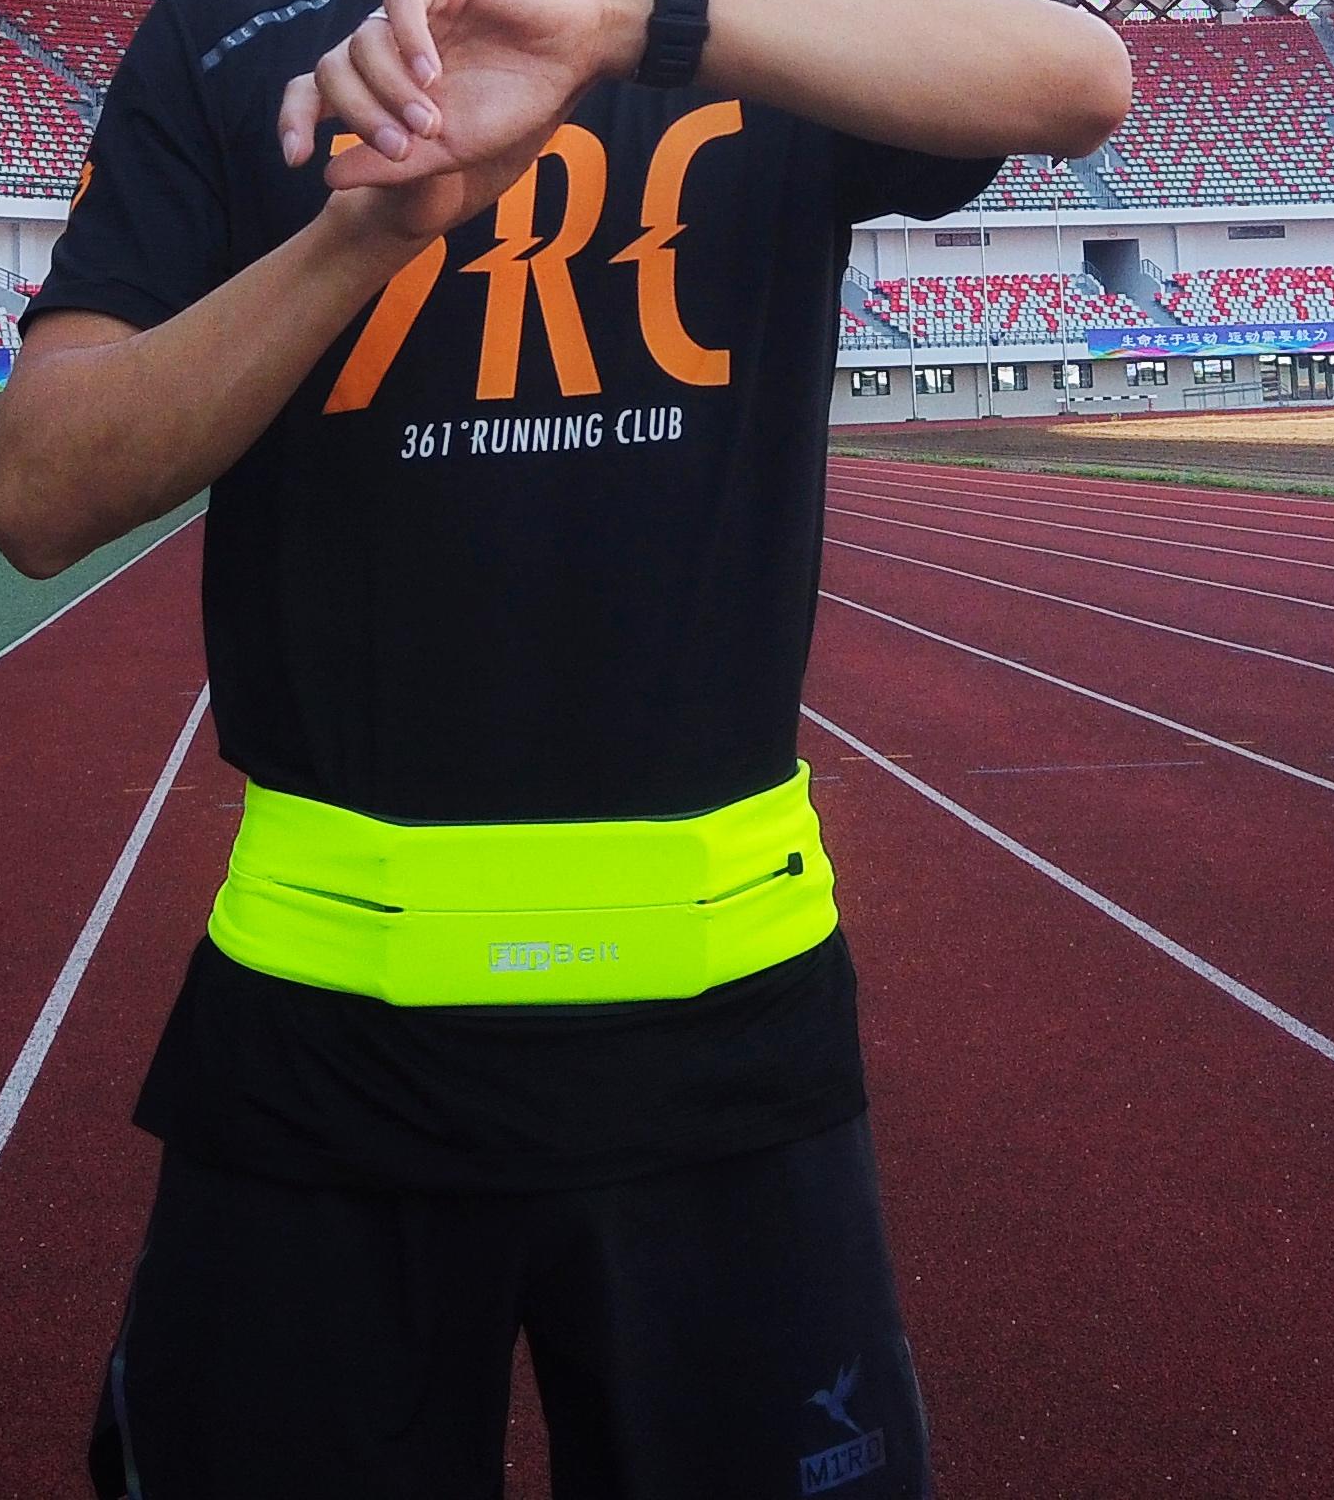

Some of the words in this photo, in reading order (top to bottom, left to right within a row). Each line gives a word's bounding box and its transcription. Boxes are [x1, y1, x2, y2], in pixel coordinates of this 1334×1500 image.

[1121, 331, 1219, 347] 生命在于运动
[1227, 328, 1328, 344] 运动需要毅力
[614, 406, 683, 444] CLUB
[489, 941, 620, 973] FlipBelt
